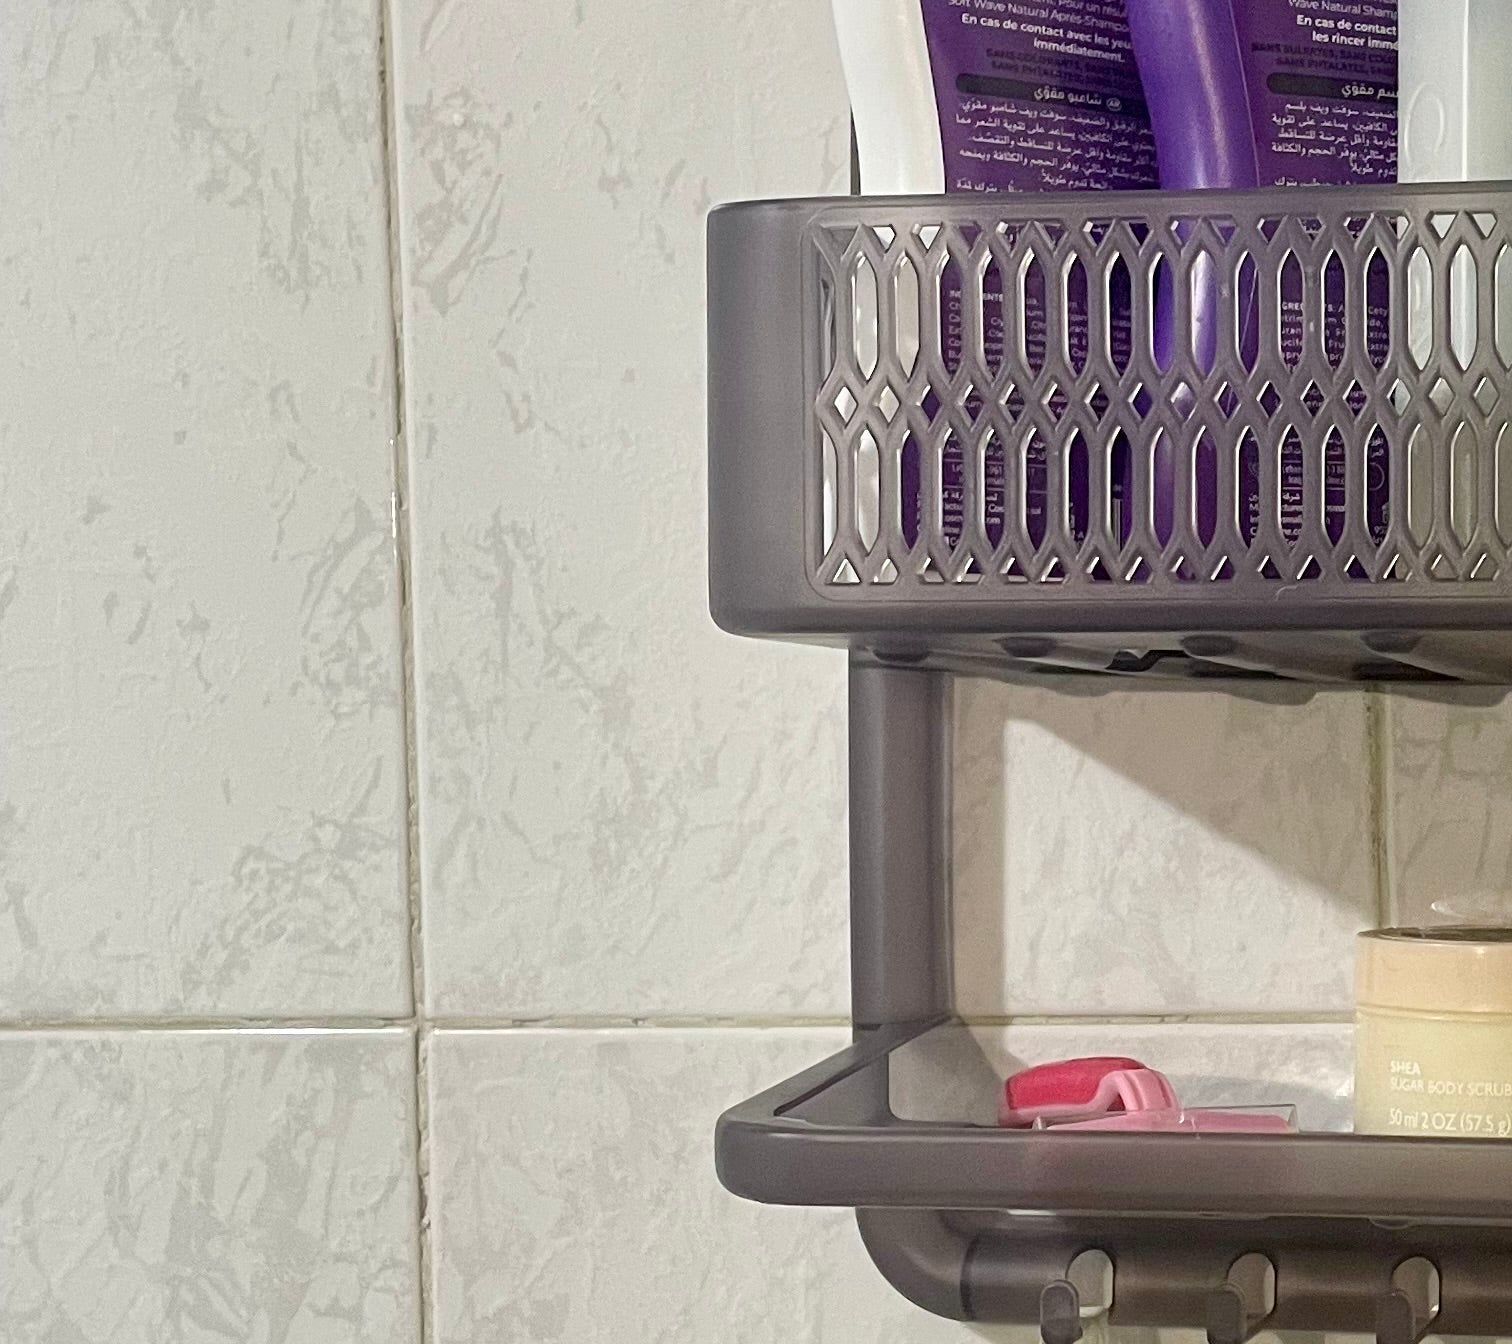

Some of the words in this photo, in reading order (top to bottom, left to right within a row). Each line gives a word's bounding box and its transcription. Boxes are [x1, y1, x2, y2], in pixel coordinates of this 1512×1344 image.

[974, 0, 1006, 12] Wave
[1008, 3, 1049, 18] Natural
[961, 13, 977, 24] En
[980, 17, 1000, 27] cas
[1002, 18, 1018, 29] de
[1020, 22, 1064, 37] contact
[1296, 14, 1312, 25] En
[1314, 18, 1335, 28] cas
[1336, 18, 1352, 30] de
[1354, 23, 1397, 35] contact
[1312, 30, 1330, 42] les
[1331, 33, 1366, 46] rincer
[1390, 1060, 1420, 1075] SHEA
[1390, 1077, 1425, 1092] SUGAR
[1428, 1080, 1463, 1095] BODY
[1466, 1081, 1512, 1096] SCRUB
[1389, 1107, 1401, 1126] 50
[1405, 1109, 1418, 1128] ml
[1421, 1112, 1429, 1129] 2
[1432, 1113, 1457, 1131] OZ
